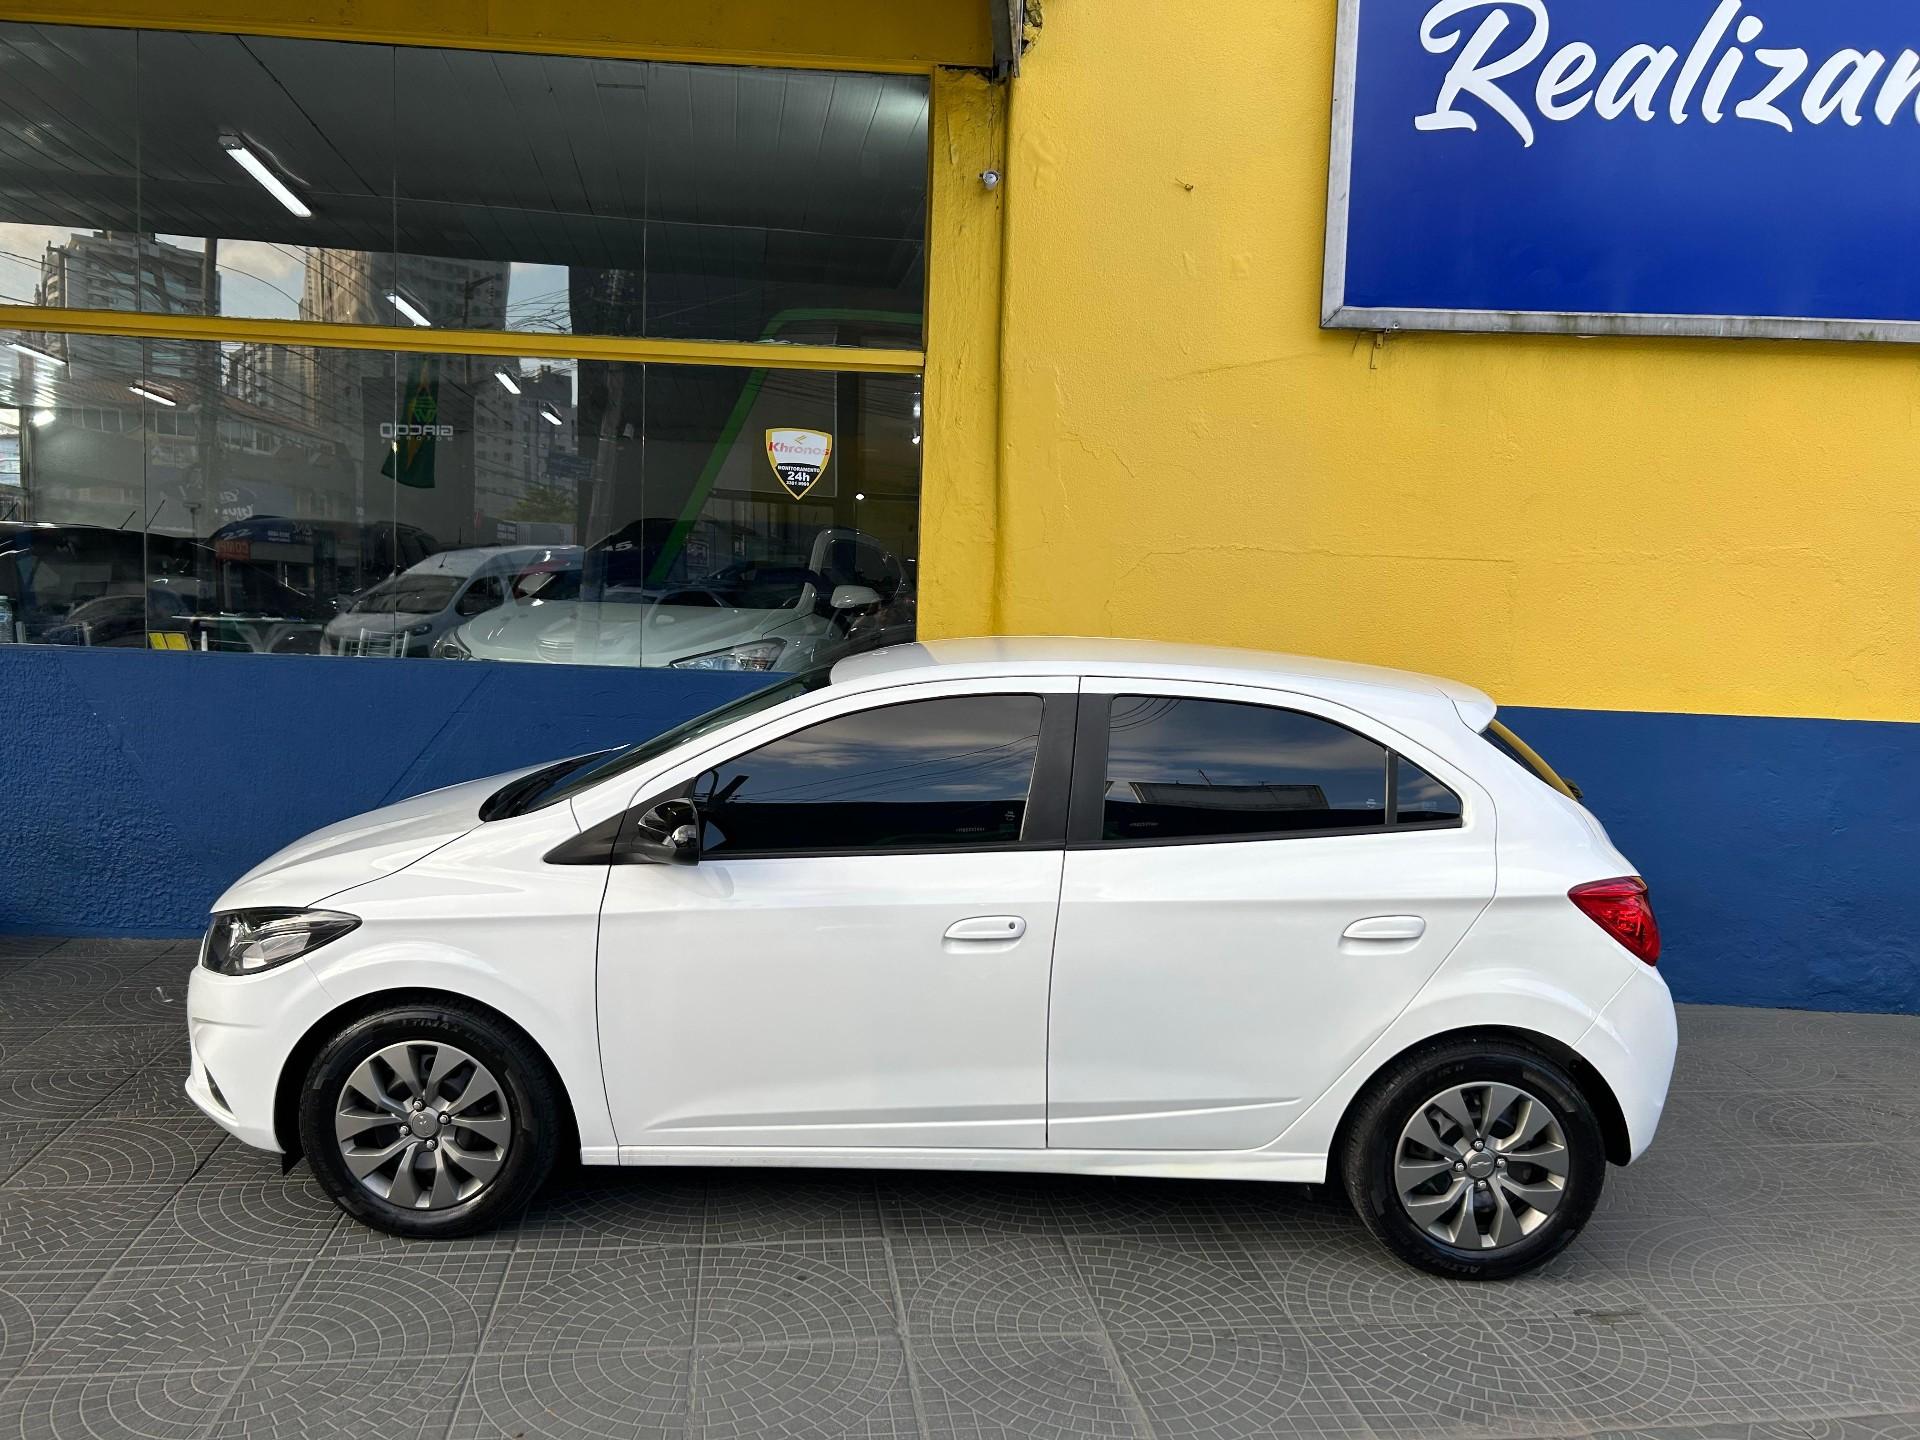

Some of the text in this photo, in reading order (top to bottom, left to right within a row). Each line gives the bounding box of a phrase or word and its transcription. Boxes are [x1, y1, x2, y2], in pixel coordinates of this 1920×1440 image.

[768, 442, 832, 456] Khronos
[777, 465, 821, 473] MONITORAMENTO
[787, 471, 810, 482] 24h
